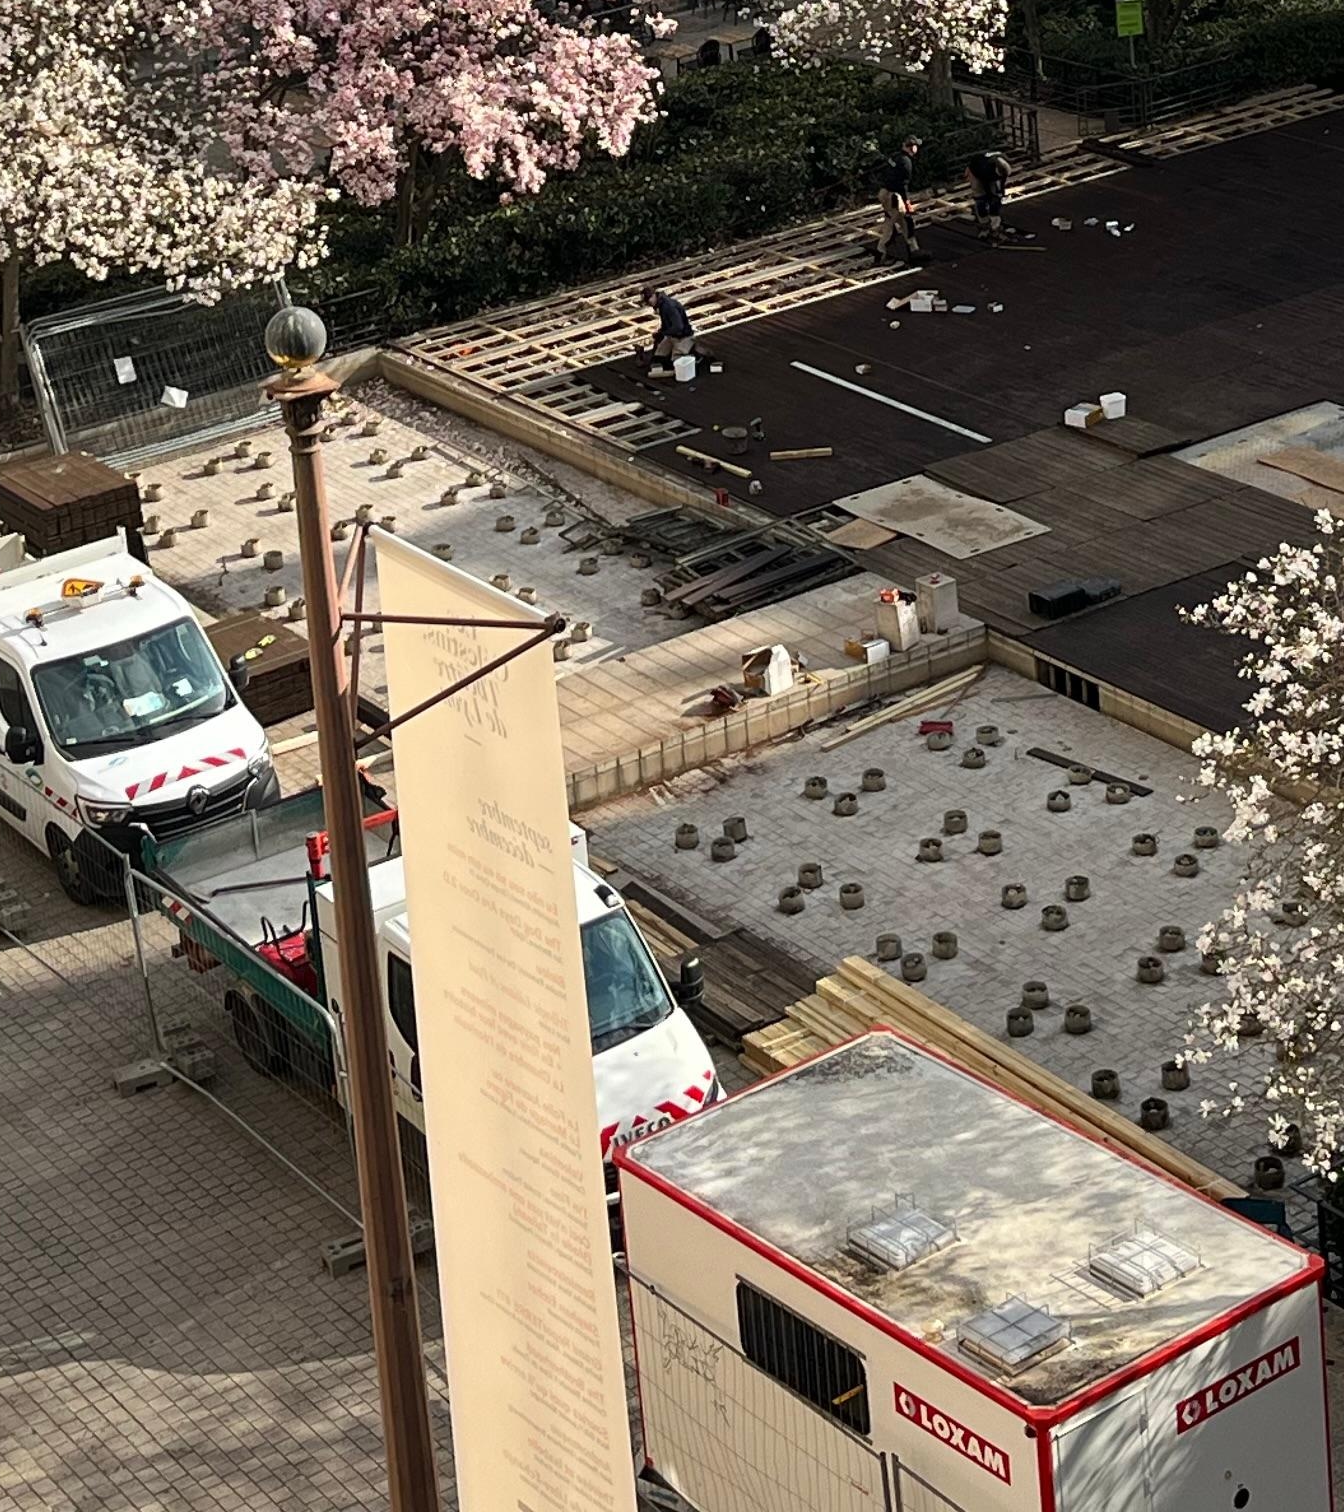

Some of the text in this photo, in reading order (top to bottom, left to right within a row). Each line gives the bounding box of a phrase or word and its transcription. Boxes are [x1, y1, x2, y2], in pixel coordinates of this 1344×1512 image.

[613, 1116, 673, 1148] IVECO
[1205, 1344, 1296, 1414] LOXAM
[920, 1403, 1006, 1476] LOXAM
